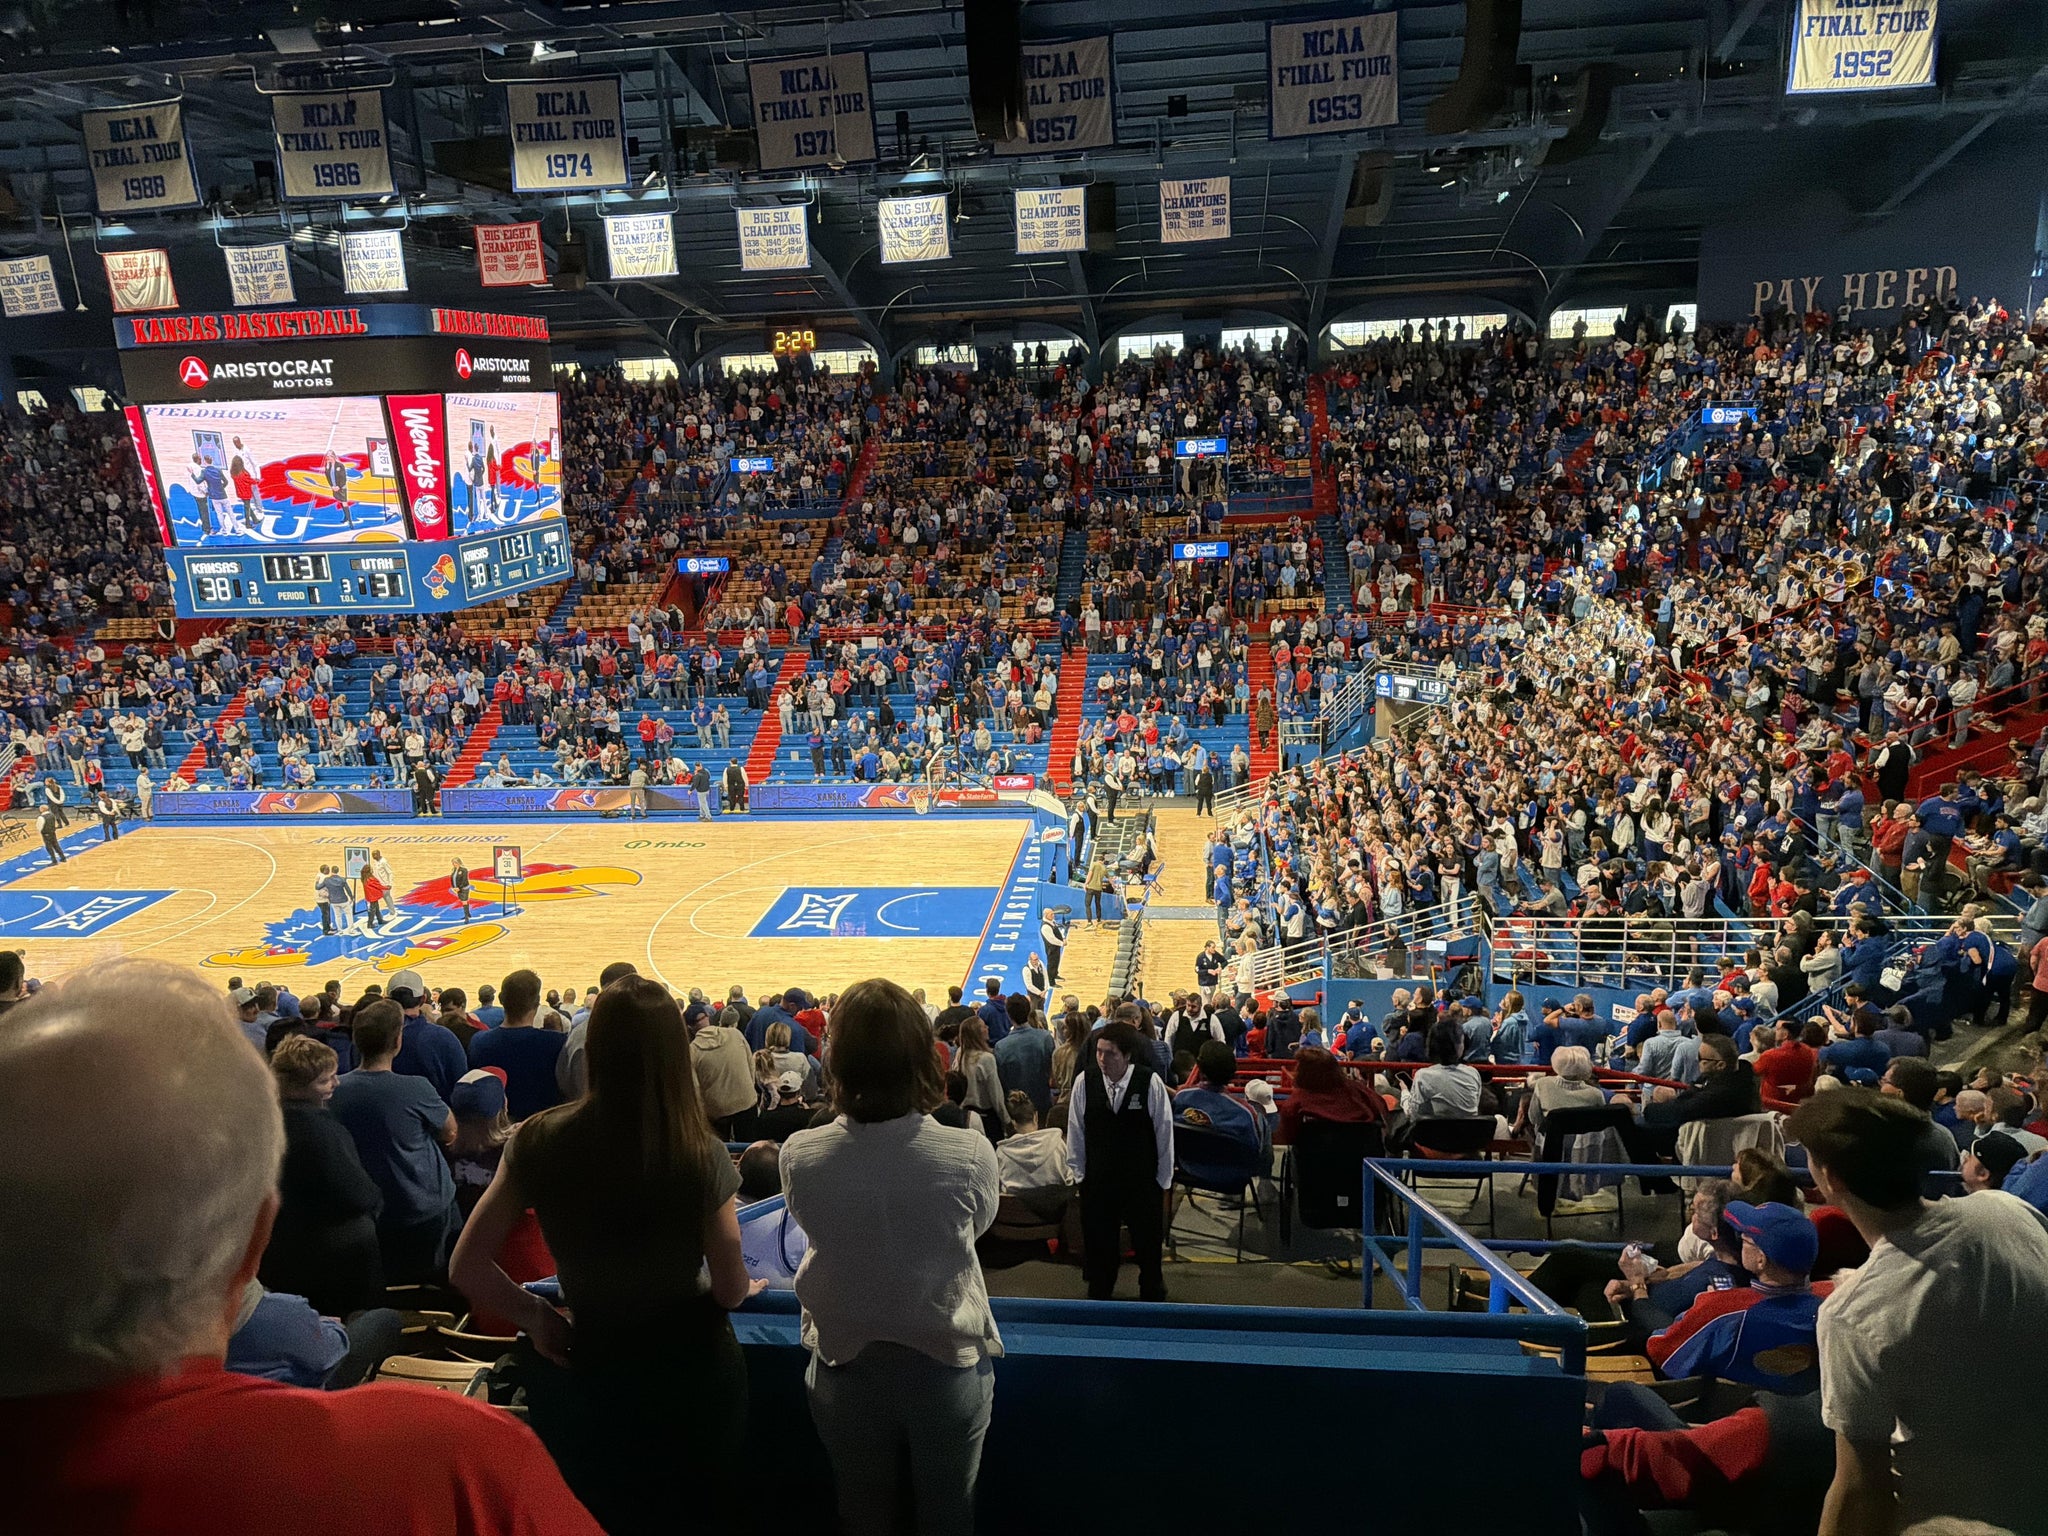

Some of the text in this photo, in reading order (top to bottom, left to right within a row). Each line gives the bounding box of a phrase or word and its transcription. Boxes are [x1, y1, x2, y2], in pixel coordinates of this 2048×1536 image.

[1804, 10, 1931, 38] FINAL FOUR
[1303, 27, 1364, 58] NCAA
[1022, 51, 1080, 79] NCAA
[1278, 55, 1391, 87] FINAL FOUR
[1833, 50, 1893, 78] 1952
[780, 65, 839, 94] NCAA
[1058, 78, 1105, 102] FOUR
[535, 90, 592, 116] NCAA
[760, 93, 866, 122] FINAL FOUR
[1308, 94, 1362, 124] 1953
[301, 99, 356, 128] NCAA
[108, 115, 158, 143] NCAA
[516, 119, 616, 142] FINAL FOUR
[1028, 115, 1077, 144] 1957
[282, 130, 381, 151] FINAL FOUR
[92, 141, 181, 168] FINAL FOUR
[546, 153, 593, 178] 1974
[313, 163, 361, 187] 1986
[123, 175, 166, 201] 1988
[1183, 182, 1208, 195] MVC
[1039, 193, 1062, 205] MVC
[1164, 194, 1227, 210] CHAMPIONS
[894, 202, 931, 215] BIG SIX
[1020, 205, 1081, 219] CHAMPIONS
[613, 218, 665, 232] BIG SEVEN
[753, 211, 790, 223] BIG SIX
[884, 214, 943, 229] CHAMPIONS
[1043, 221, 1058, 229] 1922
[1064, 219, 1080, 227] 1923
[483, 227, 532, 241] BIG EIGHT
[612, 231, 669, 245] CHAMPIONS
[743, 224, 802, 237] CHAMPIONS
[346, 236, 391, 249] BIG EIGHT
[481, 239, 537, 253] CHAMPIONS
[1043, 240, 1059, 248] 1927
[122, 257, 138, 268] BIG
[234, 249, 279, 262] BIG EIGHT
[344, 248, 397, 261] CHAMPIONS
[8, 261, 36, 274] BIG 12
[231, 260, 285, 274] CHAMPIONS
[0, 271, 50, 287] CHAMPIONS
[1748, 265, 1957, 317] PAY HEED
[132, 308, 368, 343] KANSAS BASKETBALL
[434, 307, 550, 340] KANSAS BASKETBALL
[775, 330, 815, 350] 2:29
[212, 359, 334, 379] ARISTOCRAT
[473, 357, 530, 373] ARISTOCRAT
[272, 377, 334, 389] MOTORS
[502, 374, 531, 383] MOTORS
[446, 395, 518, 412] FIELDHOUSE
[145, 406, 288, 420] FIELDHOUSE
[401, 408, 440, 489] Wendy's
[380, 455, 390, 465] 31
[463, 547, 489, 563] KANSAS
[504, 534, 531, 560] 11:31
[551, 544, 564, 567] 31
[192, 562, 239, 575] KANSAS
[274, 556, 328, 580] 11:31
[360, 558, 393, 570] UTAH
[494, 564, 499, 577] 3
[525, 563, 530, 578] 1
[470, 563, 486, 589] 38
[203, 578, 231, 601] 38
[248, 581, 258, 595] 3
[342, 578, 351, 593] 3
[377, 573, 404, 597] 31
[277, 591, 305, 600] PERIOD
[314, 587, 321, 603] 1
[817, 792, 847, 801] KANSAS
[382, 835, 508, 843] FIELDHOUSE
[655, 840, 706, 849] fnbo
[503, 860, 512, 868] 31
[989, 877, 1039, 951] NAISMITH
